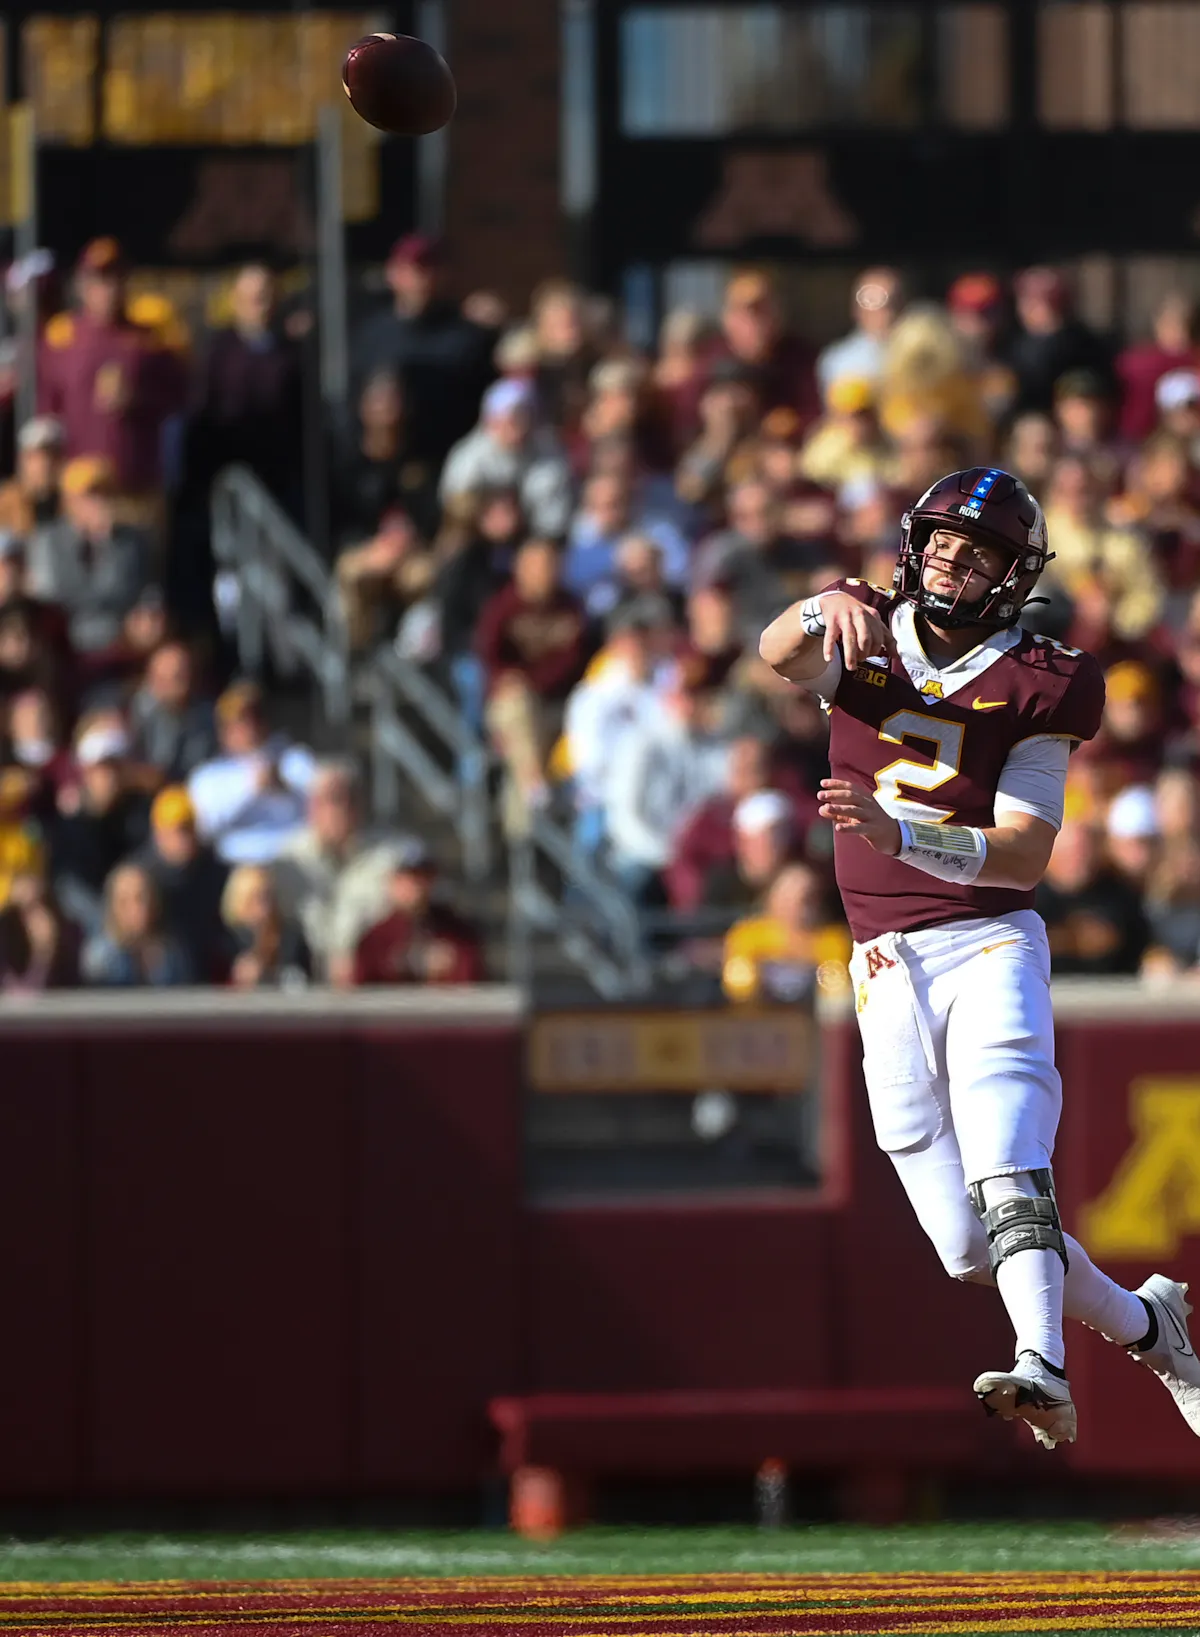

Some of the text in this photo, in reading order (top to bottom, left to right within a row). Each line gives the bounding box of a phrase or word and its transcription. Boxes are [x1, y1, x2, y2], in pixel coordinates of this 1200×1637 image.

[959, 505, 982, 520] ROW
[921, 680, 944, 698] M
[872, 708, 966, 824] 2
